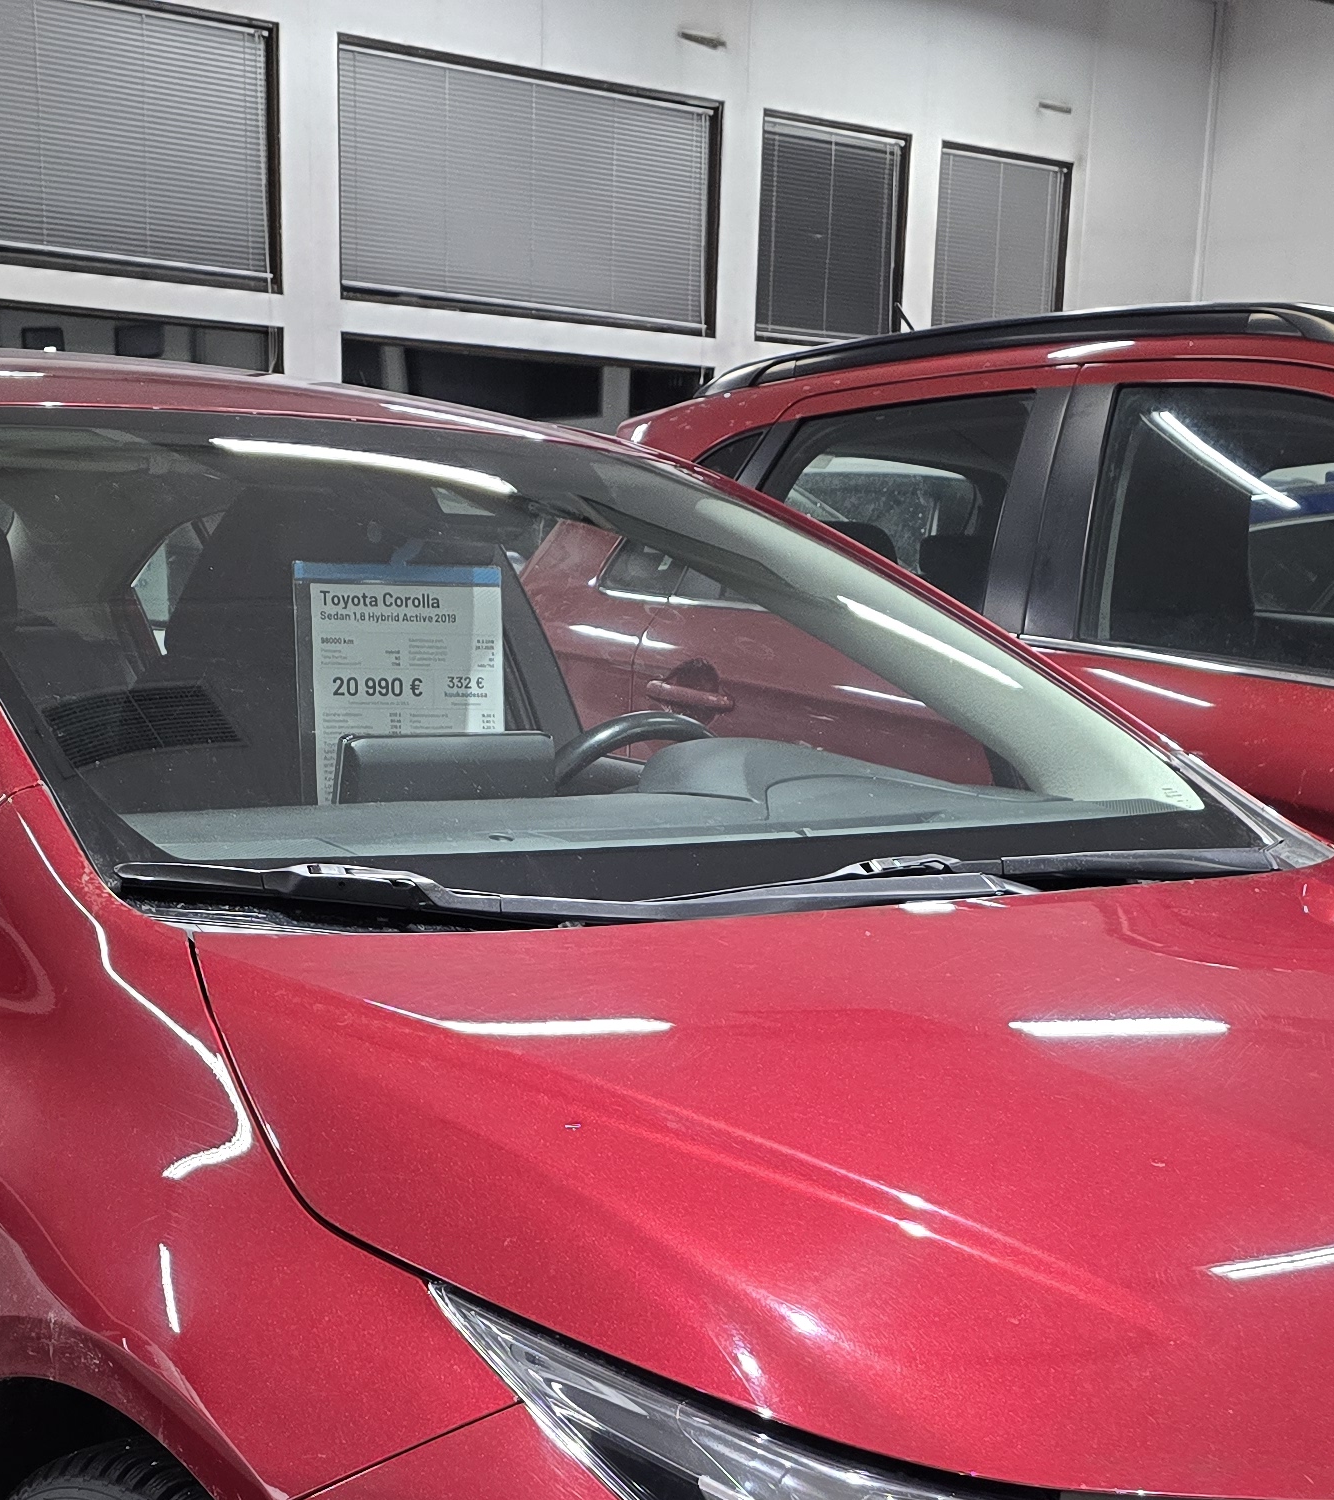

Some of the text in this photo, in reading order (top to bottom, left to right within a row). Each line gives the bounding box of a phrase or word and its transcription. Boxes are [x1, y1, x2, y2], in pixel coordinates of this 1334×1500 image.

[319, 590, 440, 609] Toyota Corolla
[320, 611, 457, 623] Sedan 1,8 Hybrid Active 2019
[343, 637, 354, 645] km
[332, 676, 423, 697] 20 990 €
[447, 676, 485, 689] 332 €
[444, 690, 488, 698] kuukaudessa
